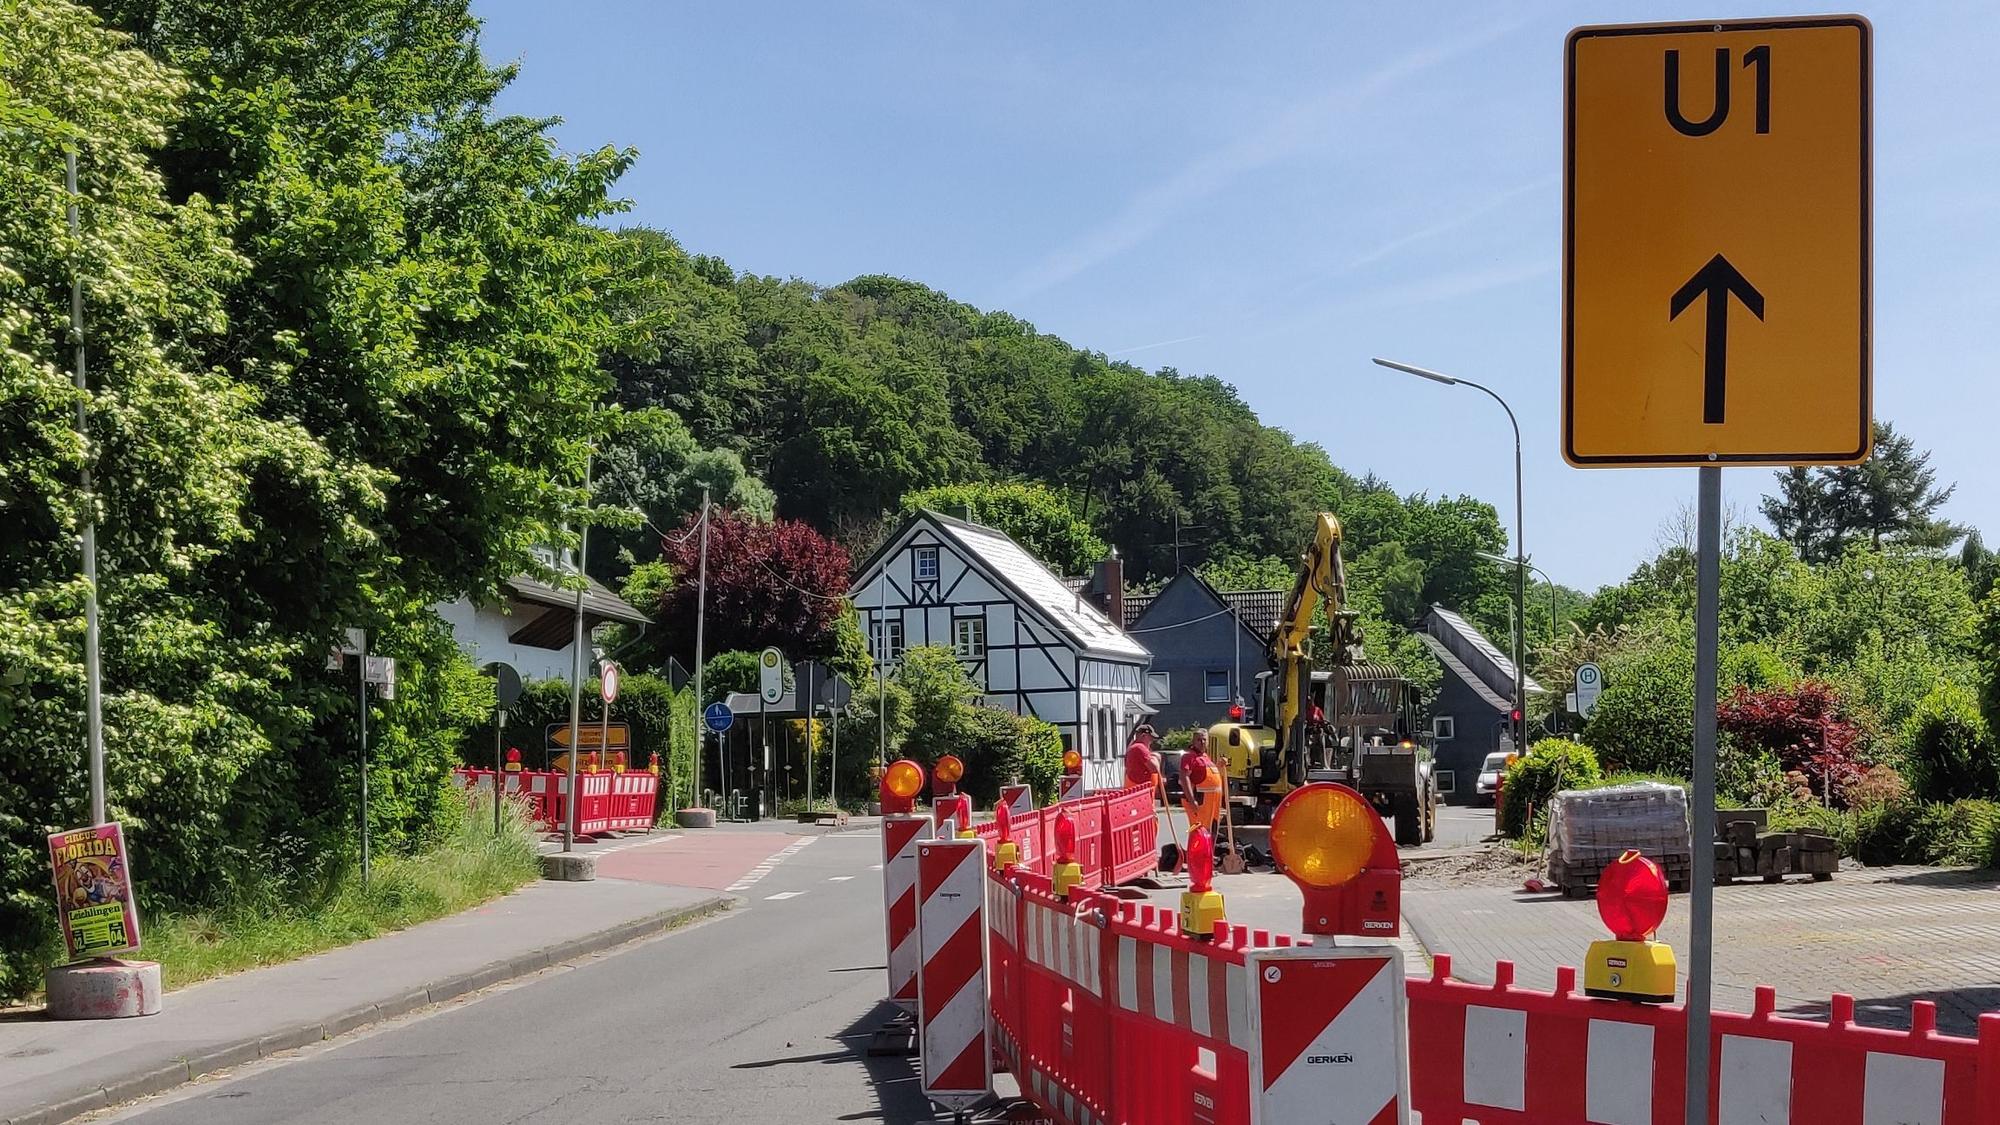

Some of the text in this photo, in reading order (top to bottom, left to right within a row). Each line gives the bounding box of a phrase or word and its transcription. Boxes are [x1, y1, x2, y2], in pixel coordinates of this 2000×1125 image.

[1664, 45, 1771, 137] U1
[64, 831, 98, 844] CIRCUS
[55, 837, 117, 866] FLORIDA
[70, 905, 121, 920] Leichlingen
[1364, 921, 1394, 929] GERKEN
[1307, 1055, 1353, 1064] GERKEN
